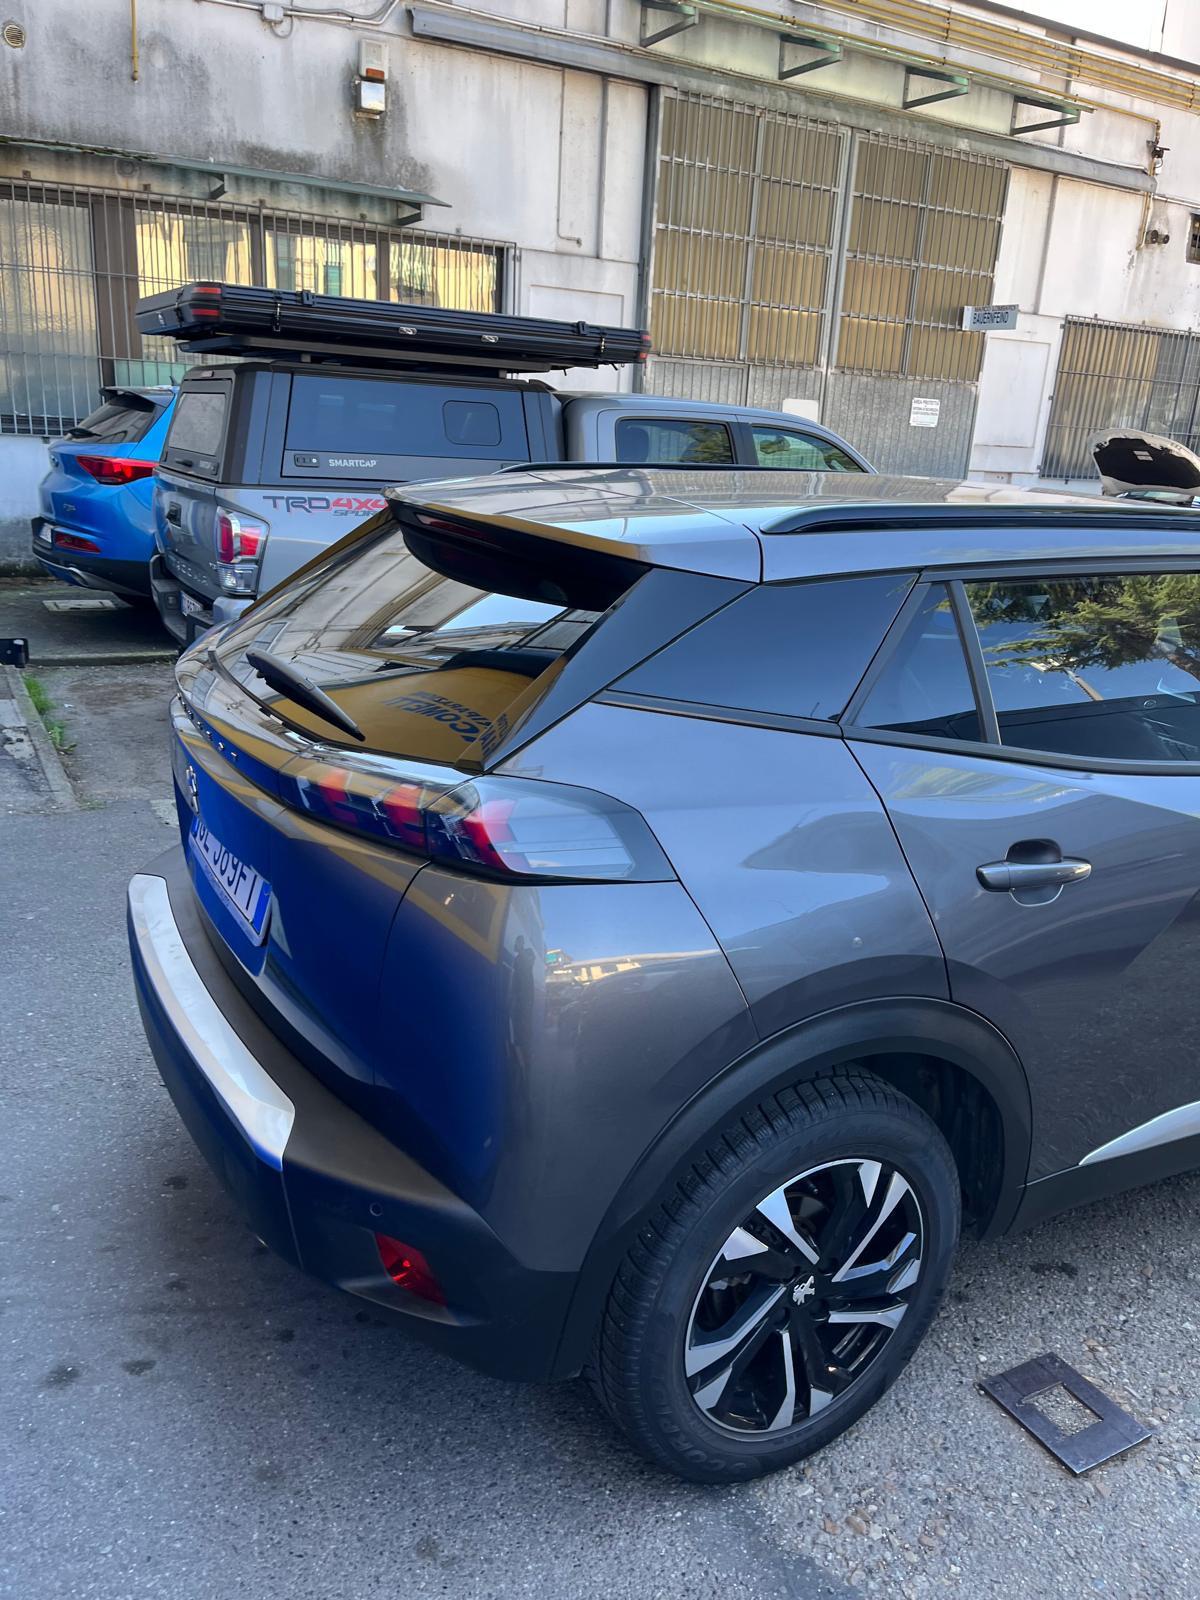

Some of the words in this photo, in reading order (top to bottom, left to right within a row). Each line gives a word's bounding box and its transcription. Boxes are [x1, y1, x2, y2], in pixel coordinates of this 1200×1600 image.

[328, 459, 377, 468] SMARTCAP
[263, 496, 331, 513] TRD
[332, 509, 378, 517] SPOR
